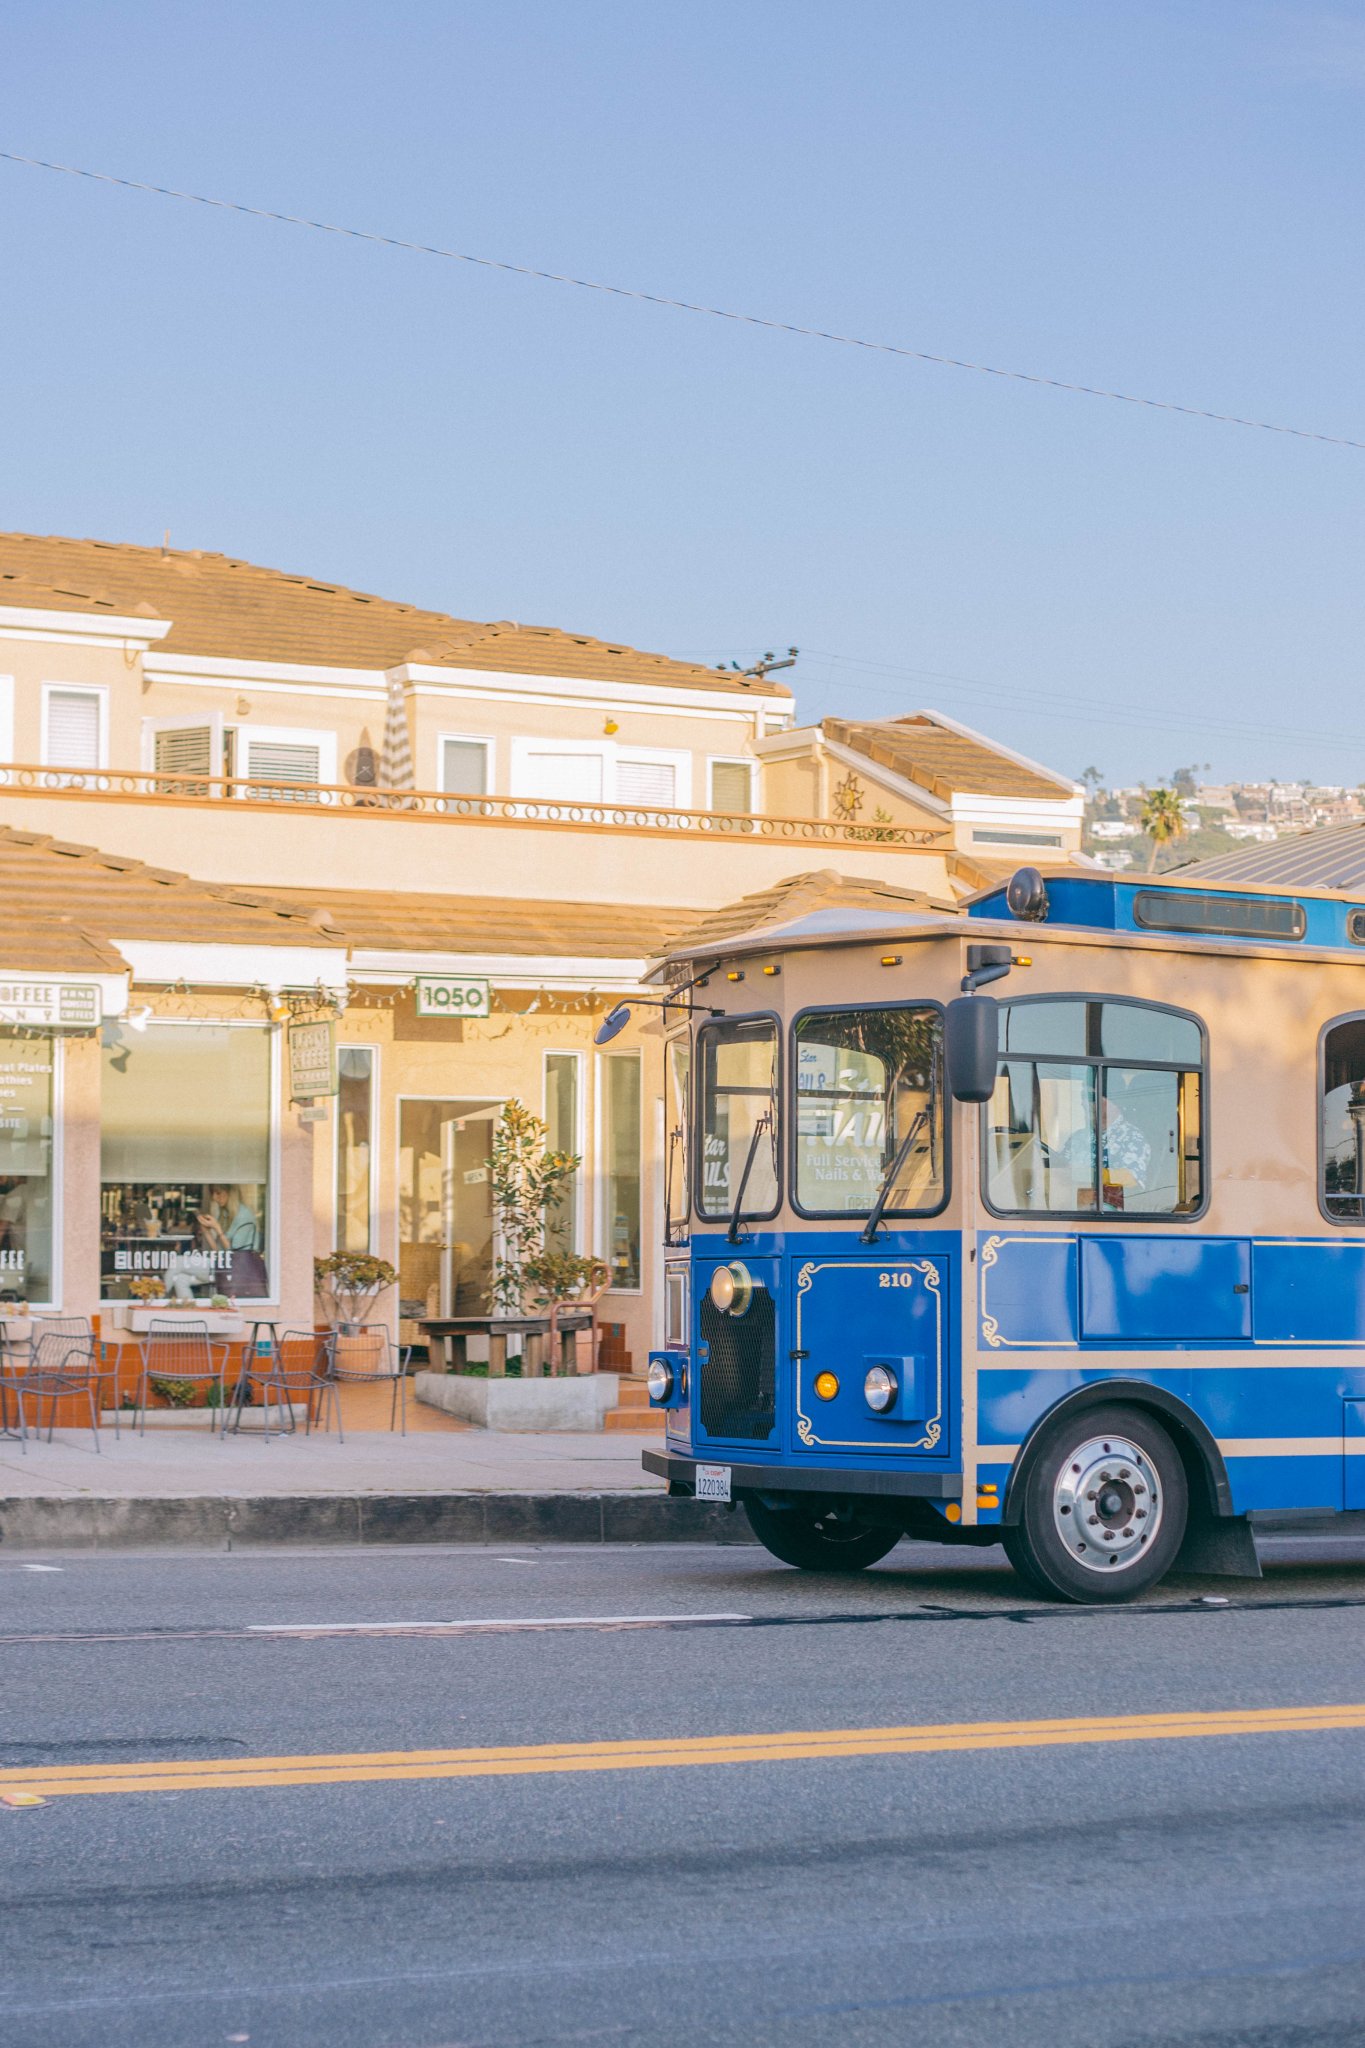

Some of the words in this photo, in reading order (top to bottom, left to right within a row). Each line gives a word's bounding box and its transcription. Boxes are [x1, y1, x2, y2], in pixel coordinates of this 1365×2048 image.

[425, 987, 483, 1007] 1050
[807, 1154, 829, 1166] Full
[835, 1154, 881, 1167] Service
[816, 1168, 848, 1181] Nails
[852, 1169, 862, 1181] &
[127, 1250, 177, 1270] LAGUNA
[879, 1273, 912, 1288] 210
[698, 1478, 729, 1497] 1220384
